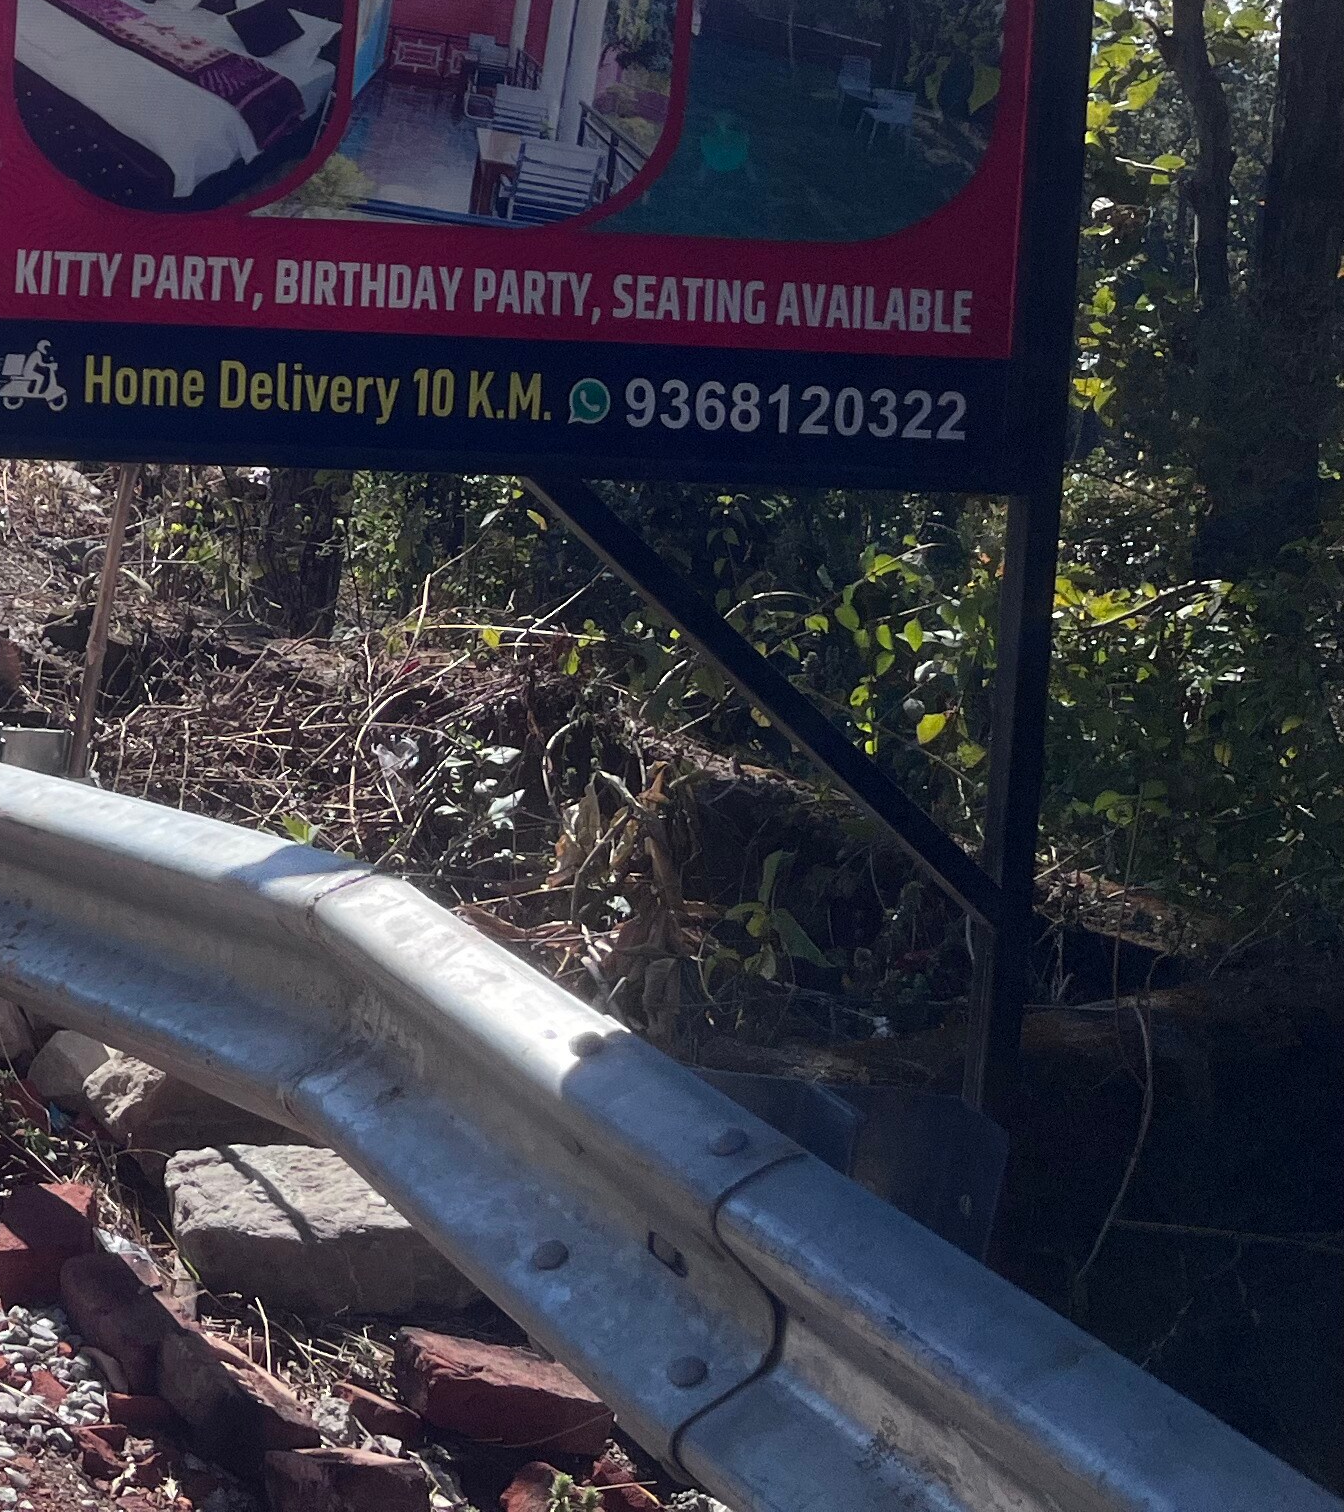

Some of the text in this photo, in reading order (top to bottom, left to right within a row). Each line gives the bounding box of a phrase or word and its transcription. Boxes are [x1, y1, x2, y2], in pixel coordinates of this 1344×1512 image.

[14, 248, 973, 334] KITTY PARTY, BIRTHDAY PARTY, SEATING AVAILABLE
[84, 355, 967, 441] Home Delivery 10 K.M. 9368120322
